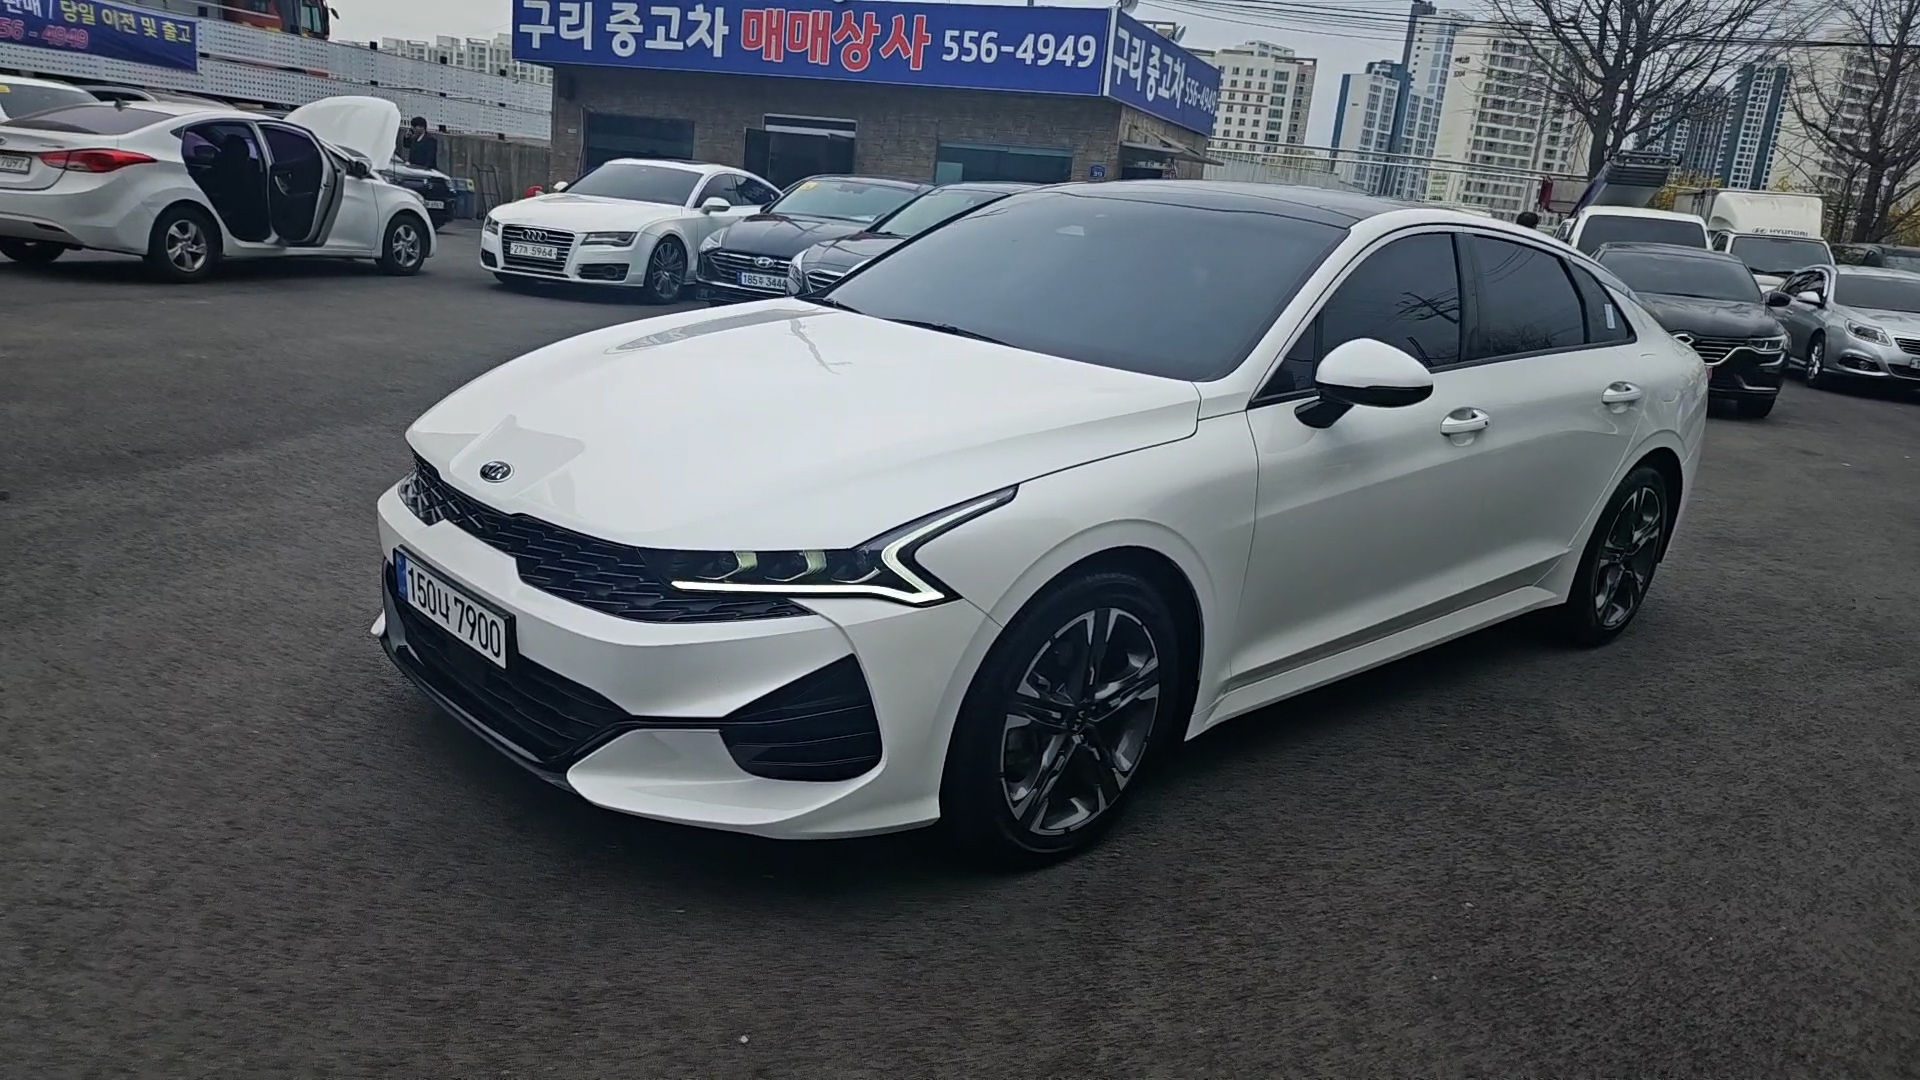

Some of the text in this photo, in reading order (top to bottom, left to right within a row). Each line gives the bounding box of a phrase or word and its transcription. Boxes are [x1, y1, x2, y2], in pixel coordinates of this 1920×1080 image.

[60, 0, 96, 25] 당일
[101, 9, 138, 34] 이전
[140, 16, 158, 38] 및
[161, 20, 191, 42] 출고
[519, 0, 1096, 72] 구리 중고차 매매상사 556-4949
[1113, 27, 1217, 114] 구리 중고차 556-4949
[530, 246, 553, 258] 5964
[1769, 228, 1808, 237] HYUNDAI
[766, 276, 787, 289] 3444
[453, 595, 501, 659] 7900
